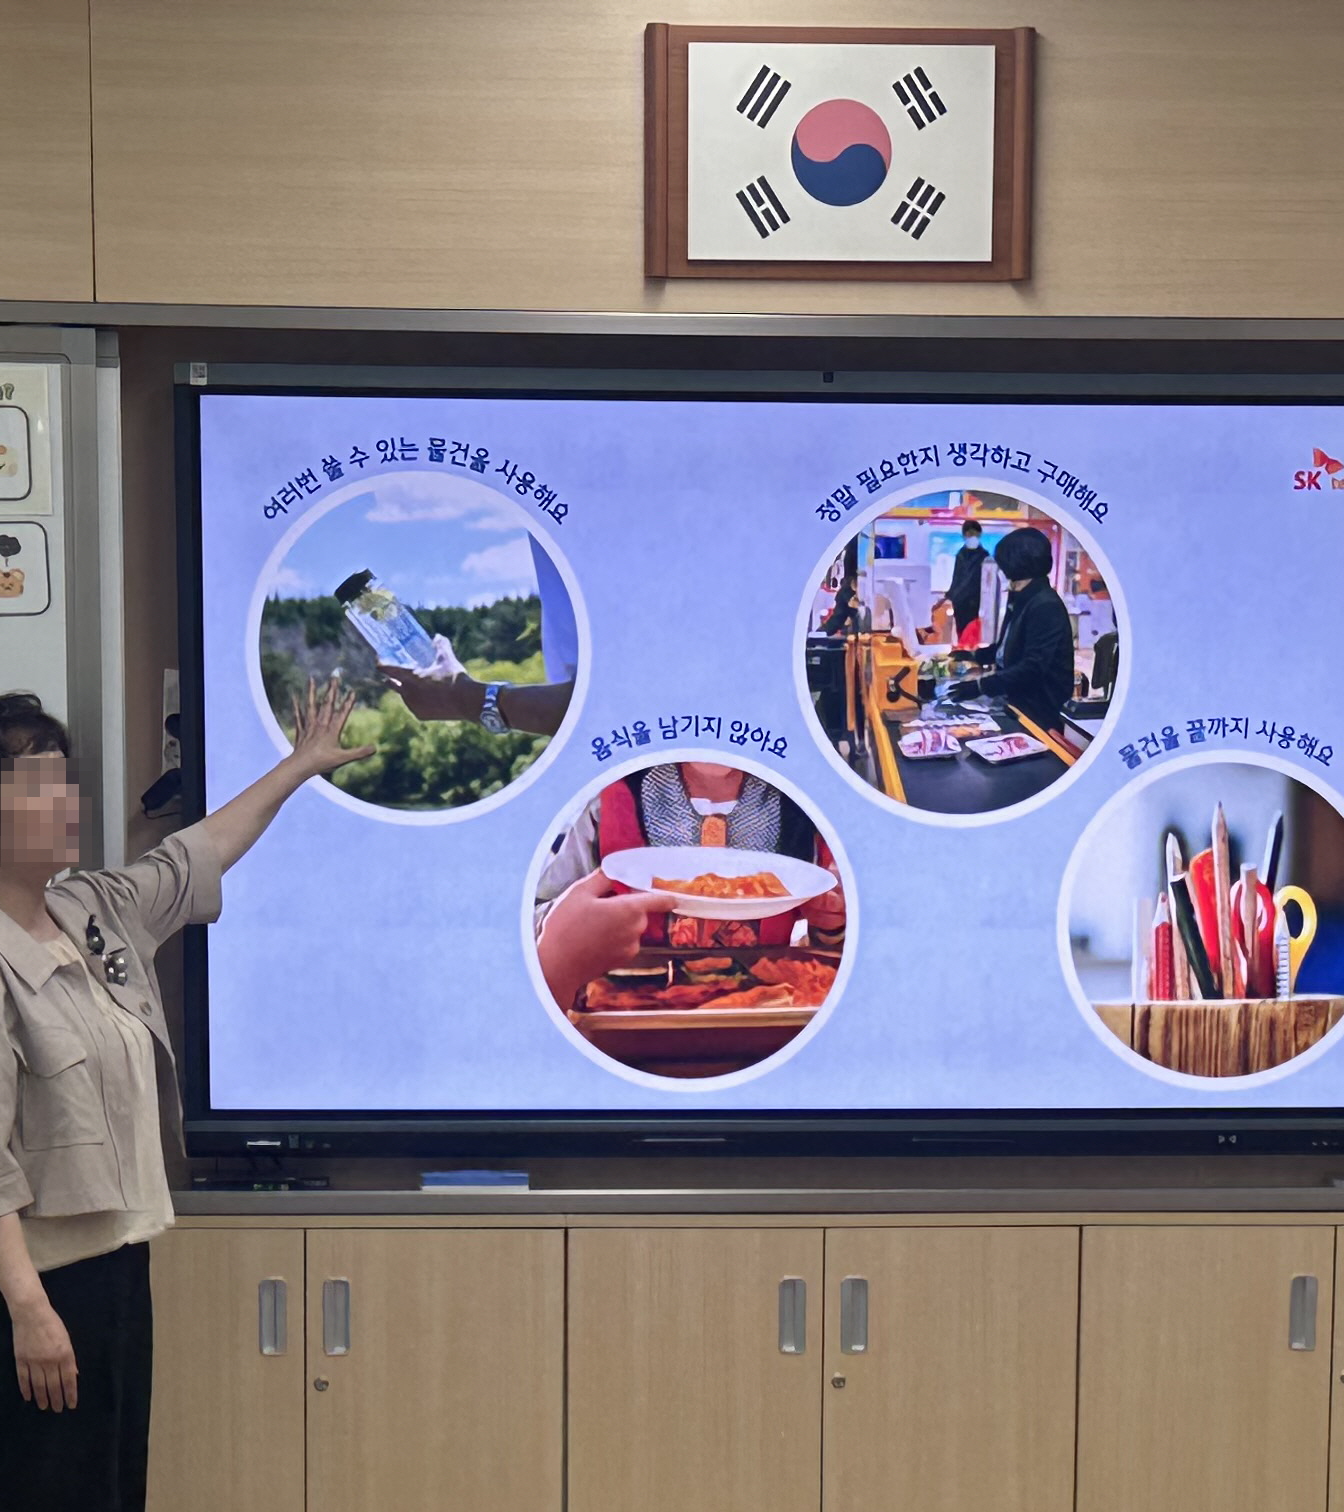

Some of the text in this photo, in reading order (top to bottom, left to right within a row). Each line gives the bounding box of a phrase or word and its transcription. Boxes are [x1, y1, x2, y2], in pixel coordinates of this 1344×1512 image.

[262, 436, 571, 526] 여러번 쓸 수 있는 물건을 사용해요
[814, 442, 1111, 526] 정말 필요한지 생각하고 구매해요
[1293, 470, 1322, 491] SK
[590, 714, 789, 761] 음식을 남기지 않아요
[1118, 716, 1335, 769] 물건을 끝까지 사용해요
